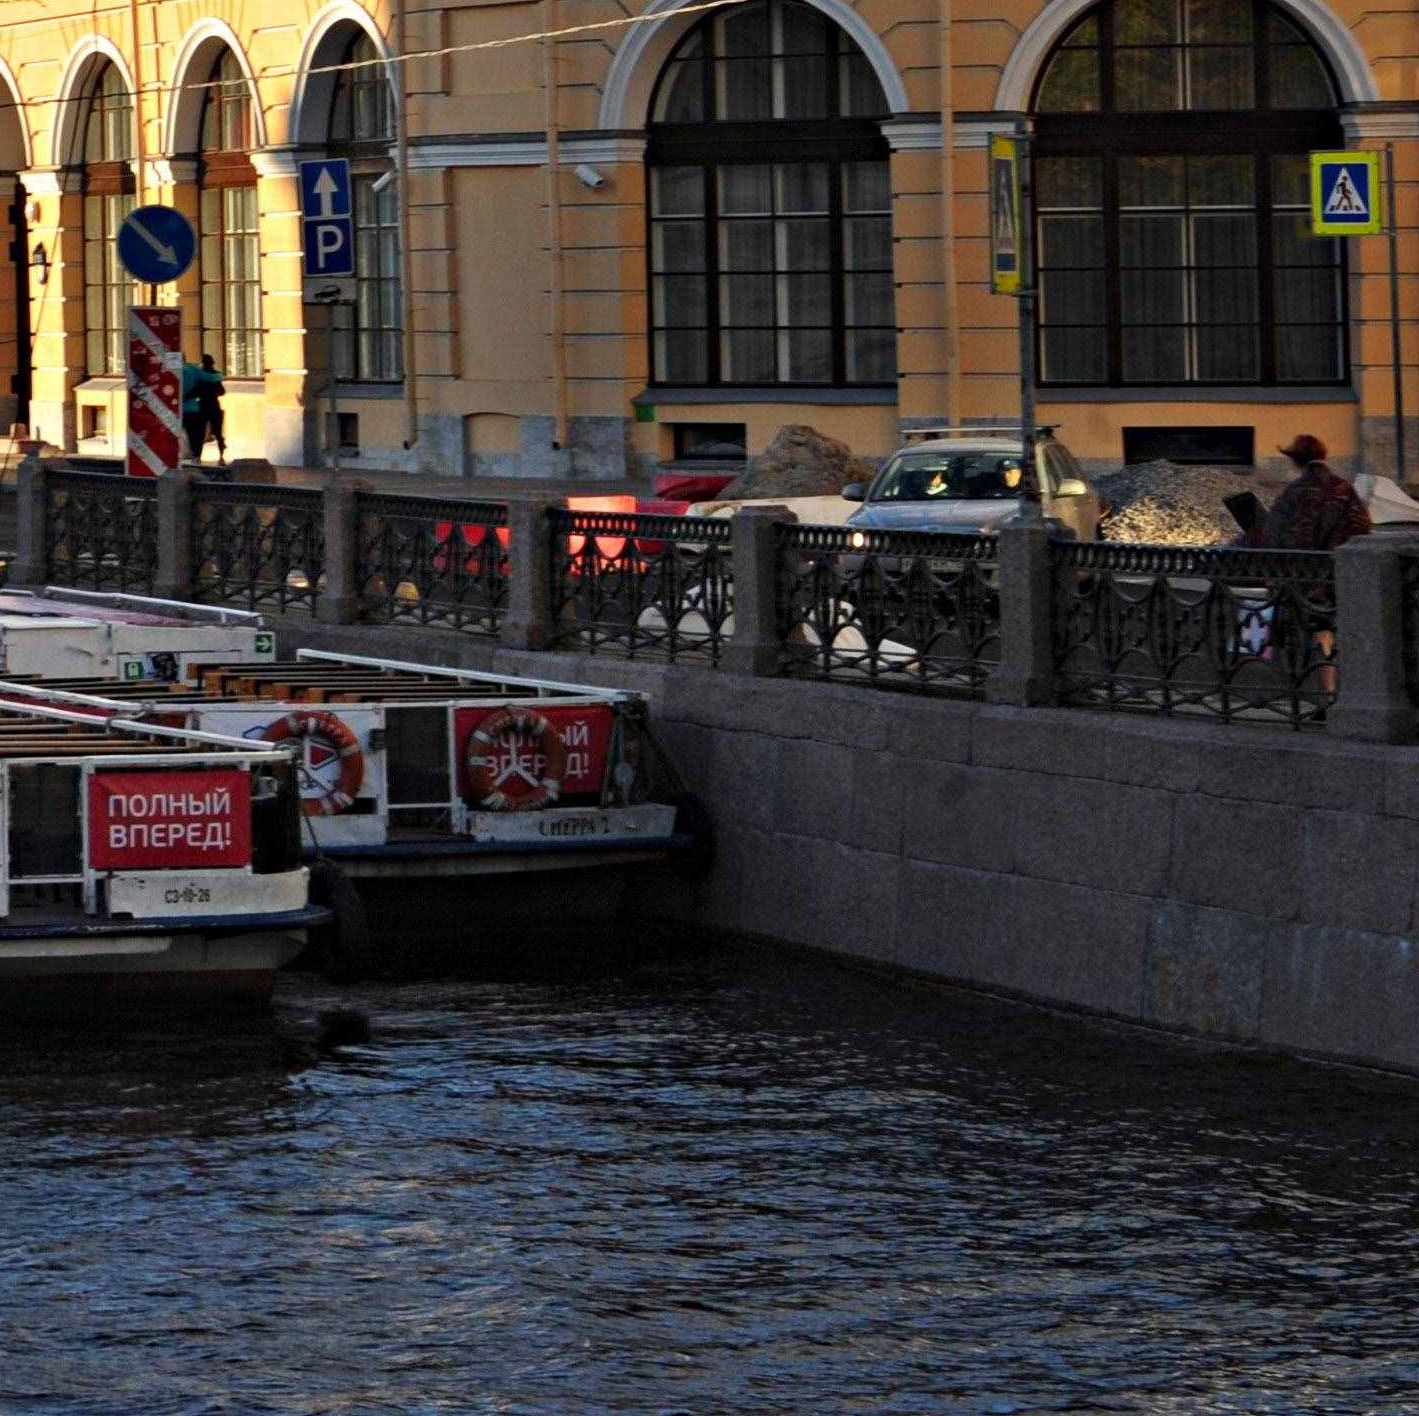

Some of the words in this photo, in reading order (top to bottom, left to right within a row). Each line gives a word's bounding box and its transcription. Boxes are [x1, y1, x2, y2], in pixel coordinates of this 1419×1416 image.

[317, 225, 344, 269] P
[108, 787, 231, 817] ПОЛНЫЙ
[108, 823, 231, 850] ВПЕРЕД!
